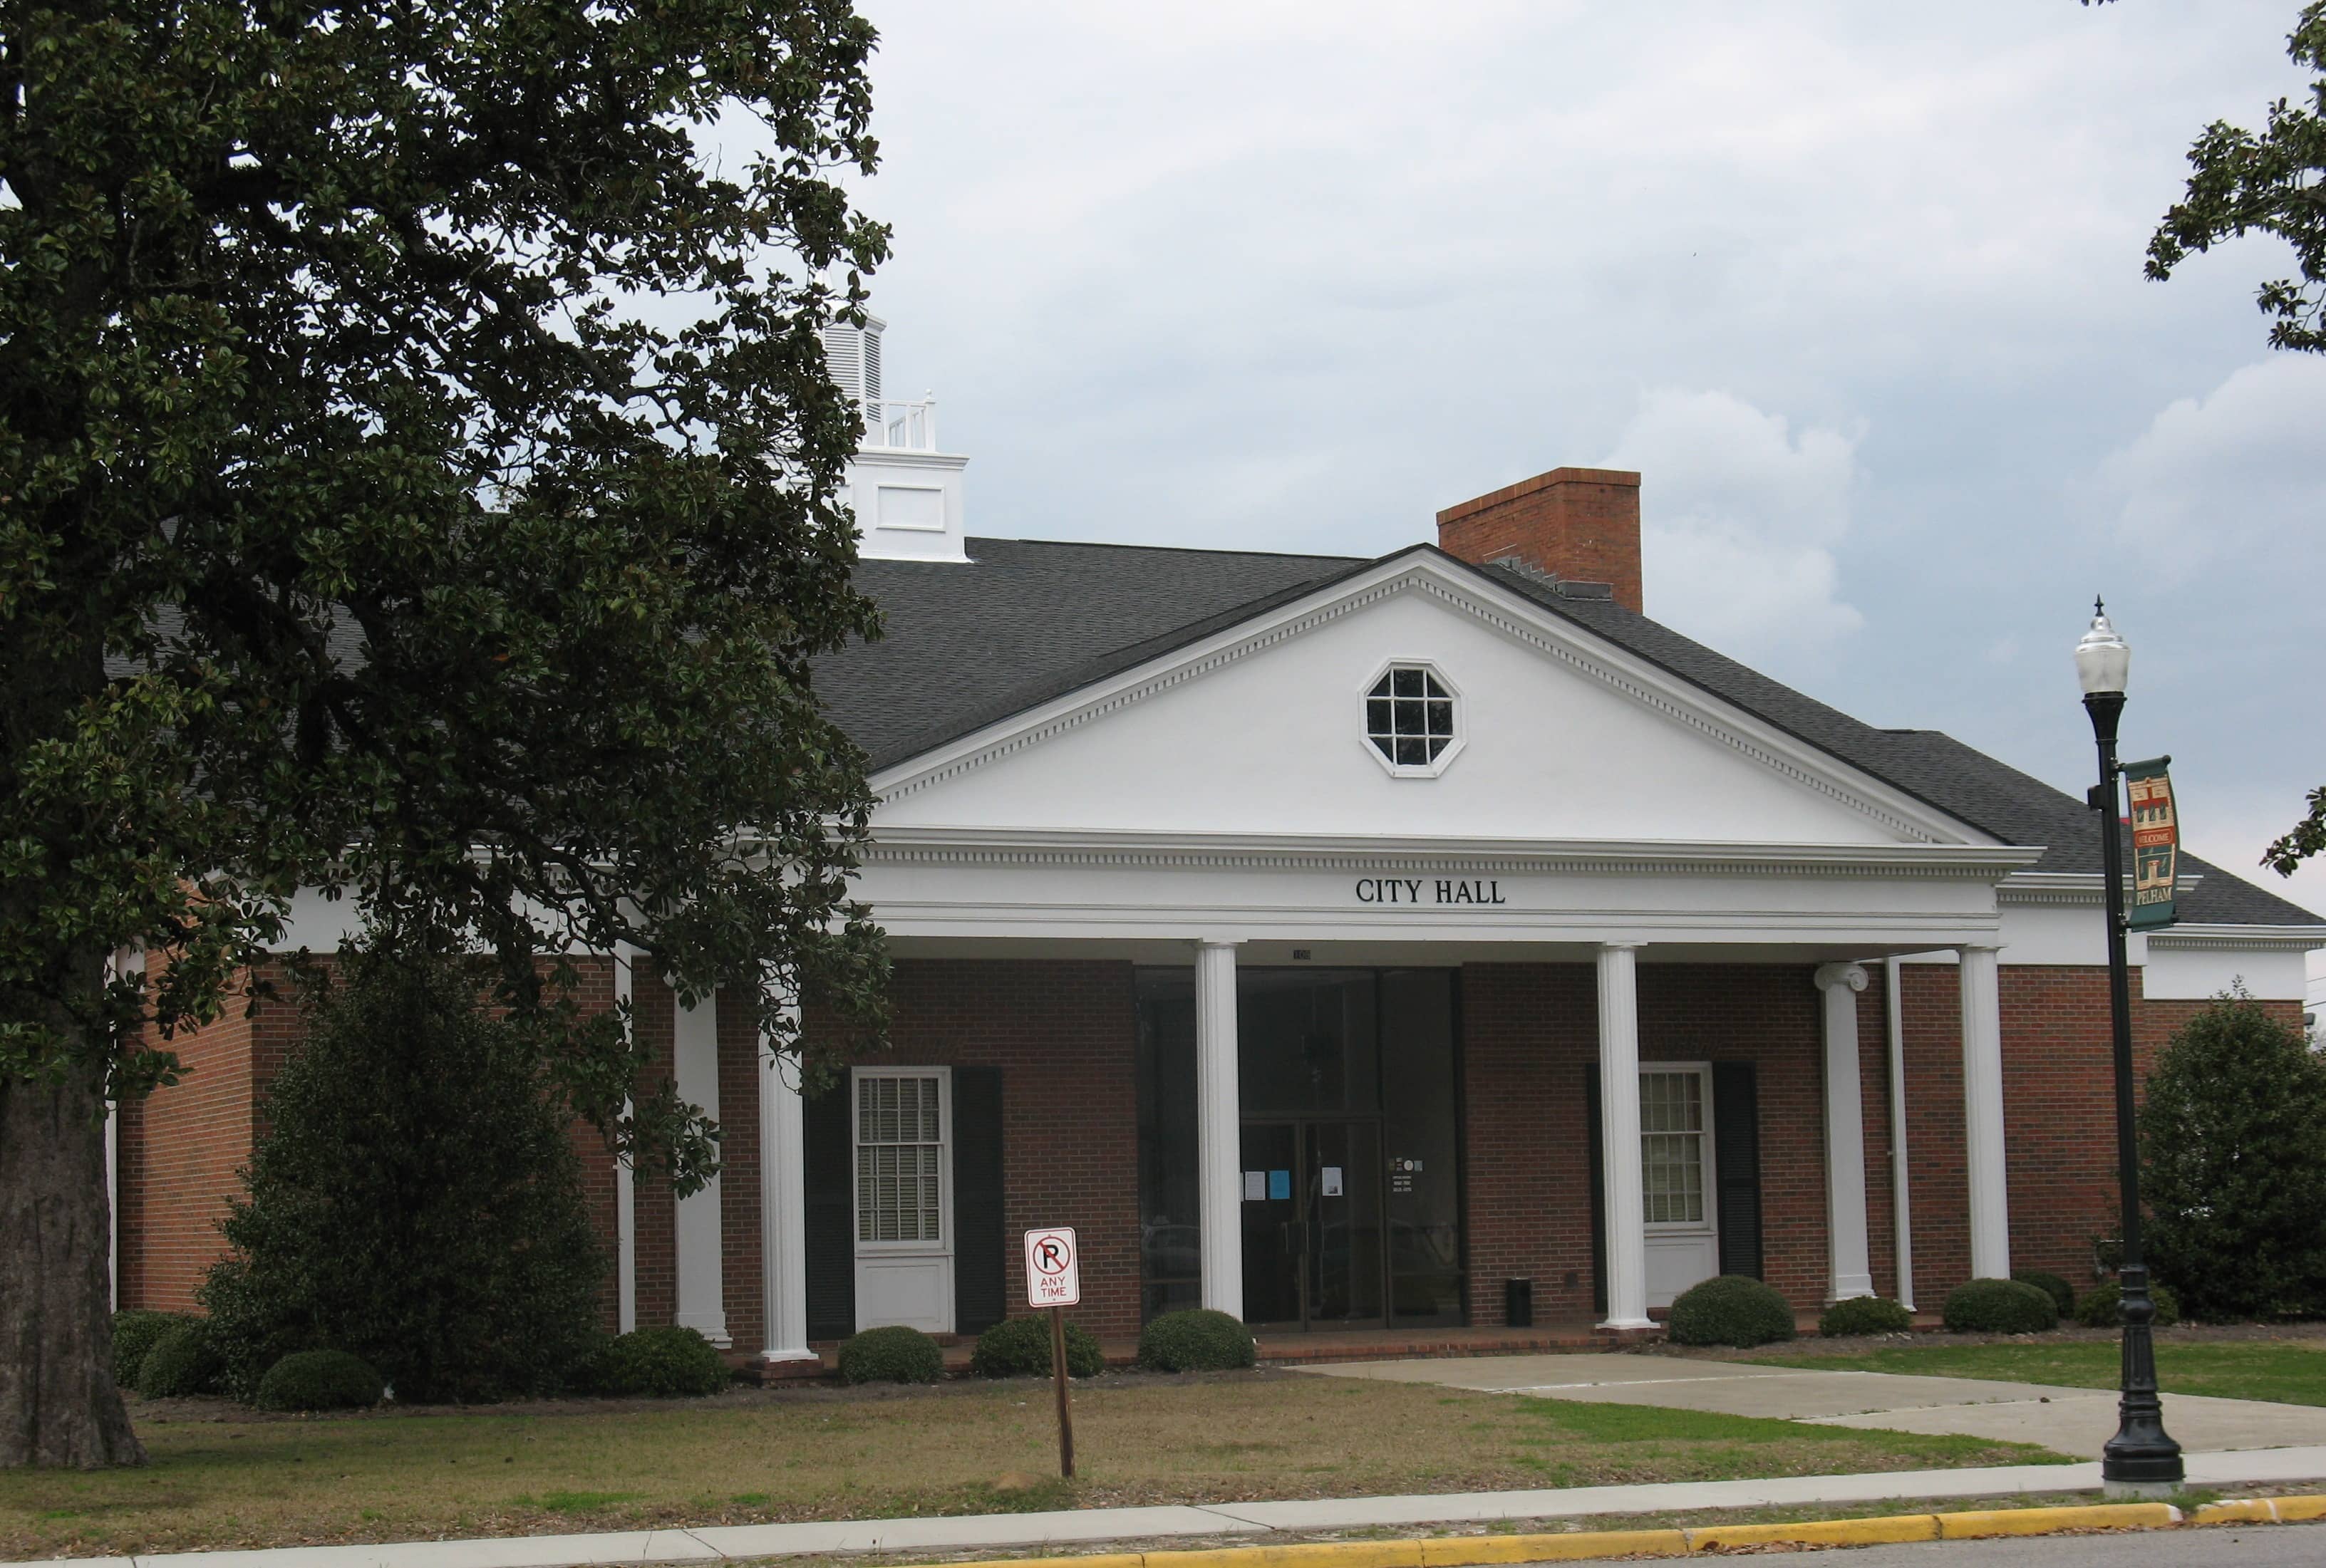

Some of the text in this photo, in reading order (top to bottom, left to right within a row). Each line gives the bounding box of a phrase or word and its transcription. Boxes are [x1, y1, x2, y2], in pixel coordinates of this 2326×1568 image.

[1355, 878, 1506, 903] CITY HALL
[2136, 887, 2173, 906] PELHAM
[1040, 1277, 1065, 1287] ANY
[1040, 1287, 1066, 1297] TIME
